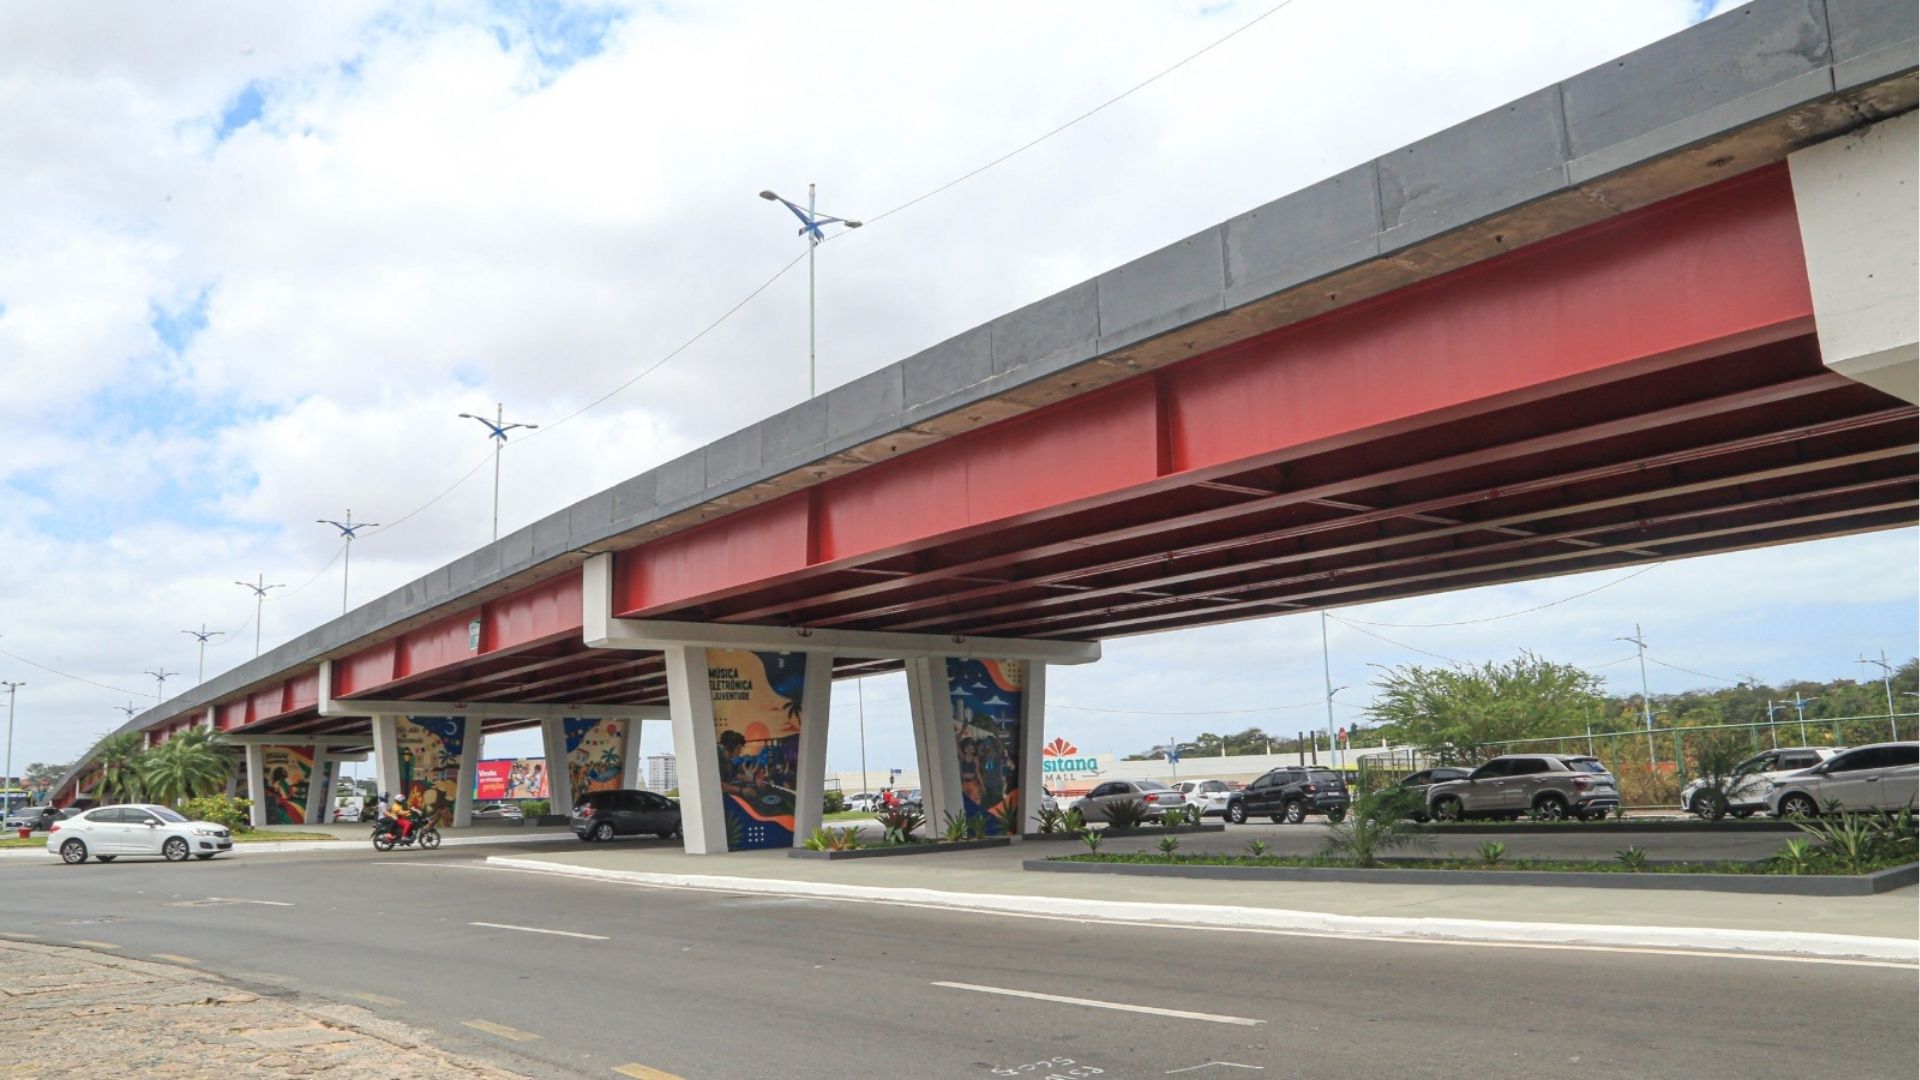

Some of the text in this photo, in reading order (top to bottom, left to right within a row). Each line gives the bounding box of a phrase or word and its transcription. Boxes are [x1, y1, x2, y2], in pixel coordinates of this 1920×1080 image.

[708, 667, 739, 679] MÚSICA
[709, 679, 752, 690] ELETRÔNICA
[1045, 773, 1076, 782] MALL
